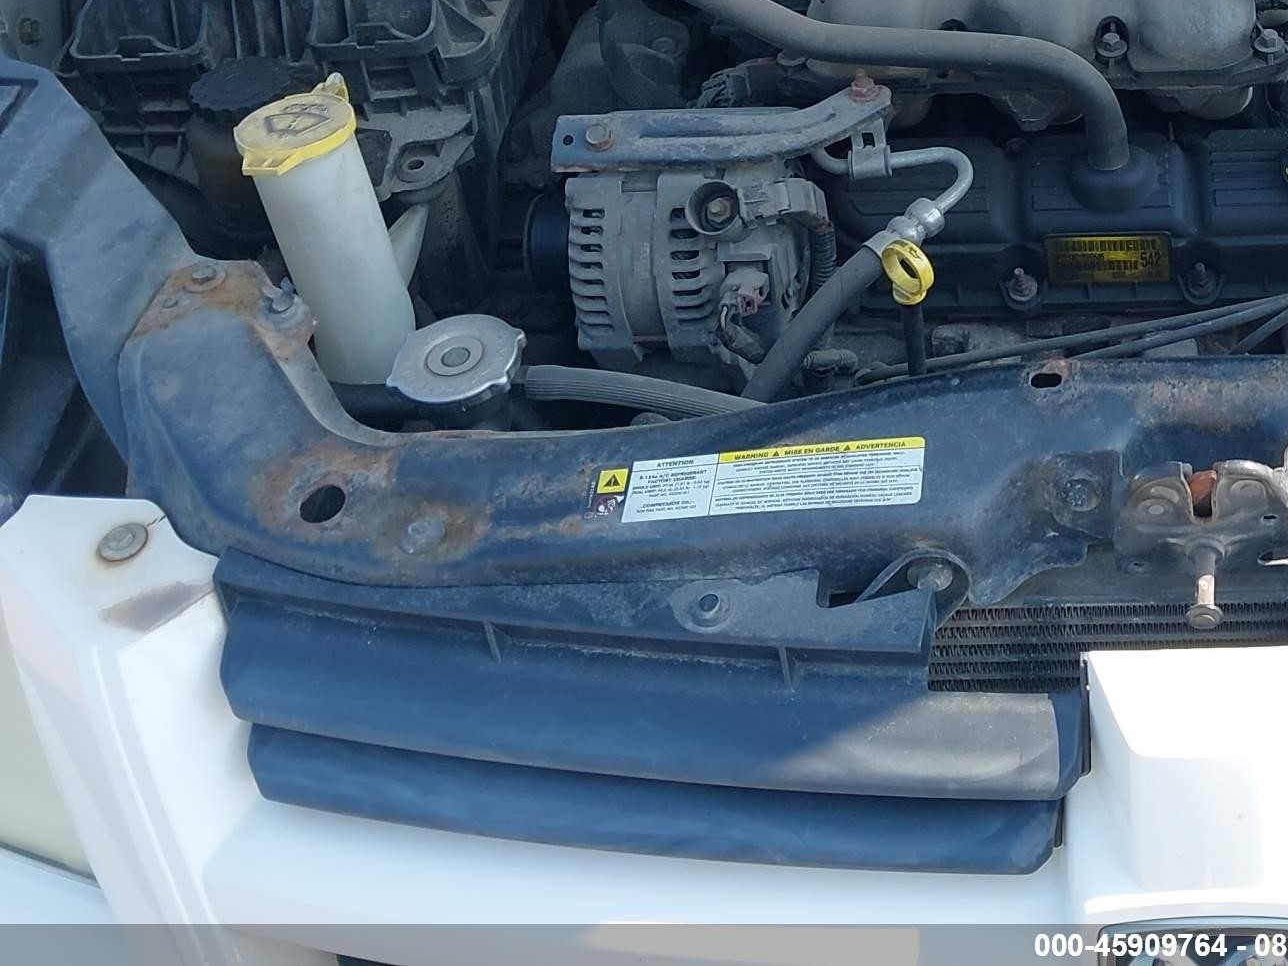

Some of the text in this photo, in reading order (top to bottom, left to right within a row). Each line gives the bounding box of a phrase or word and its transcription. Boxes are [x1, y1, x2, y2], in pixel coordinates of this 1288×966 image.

[1140, 250, 1161, 268] 542
[733, 441, 907, 461] WARNING MISE EN GARDE ADVERTENCIA
[656, 459, 695, 468] ATTENTION
